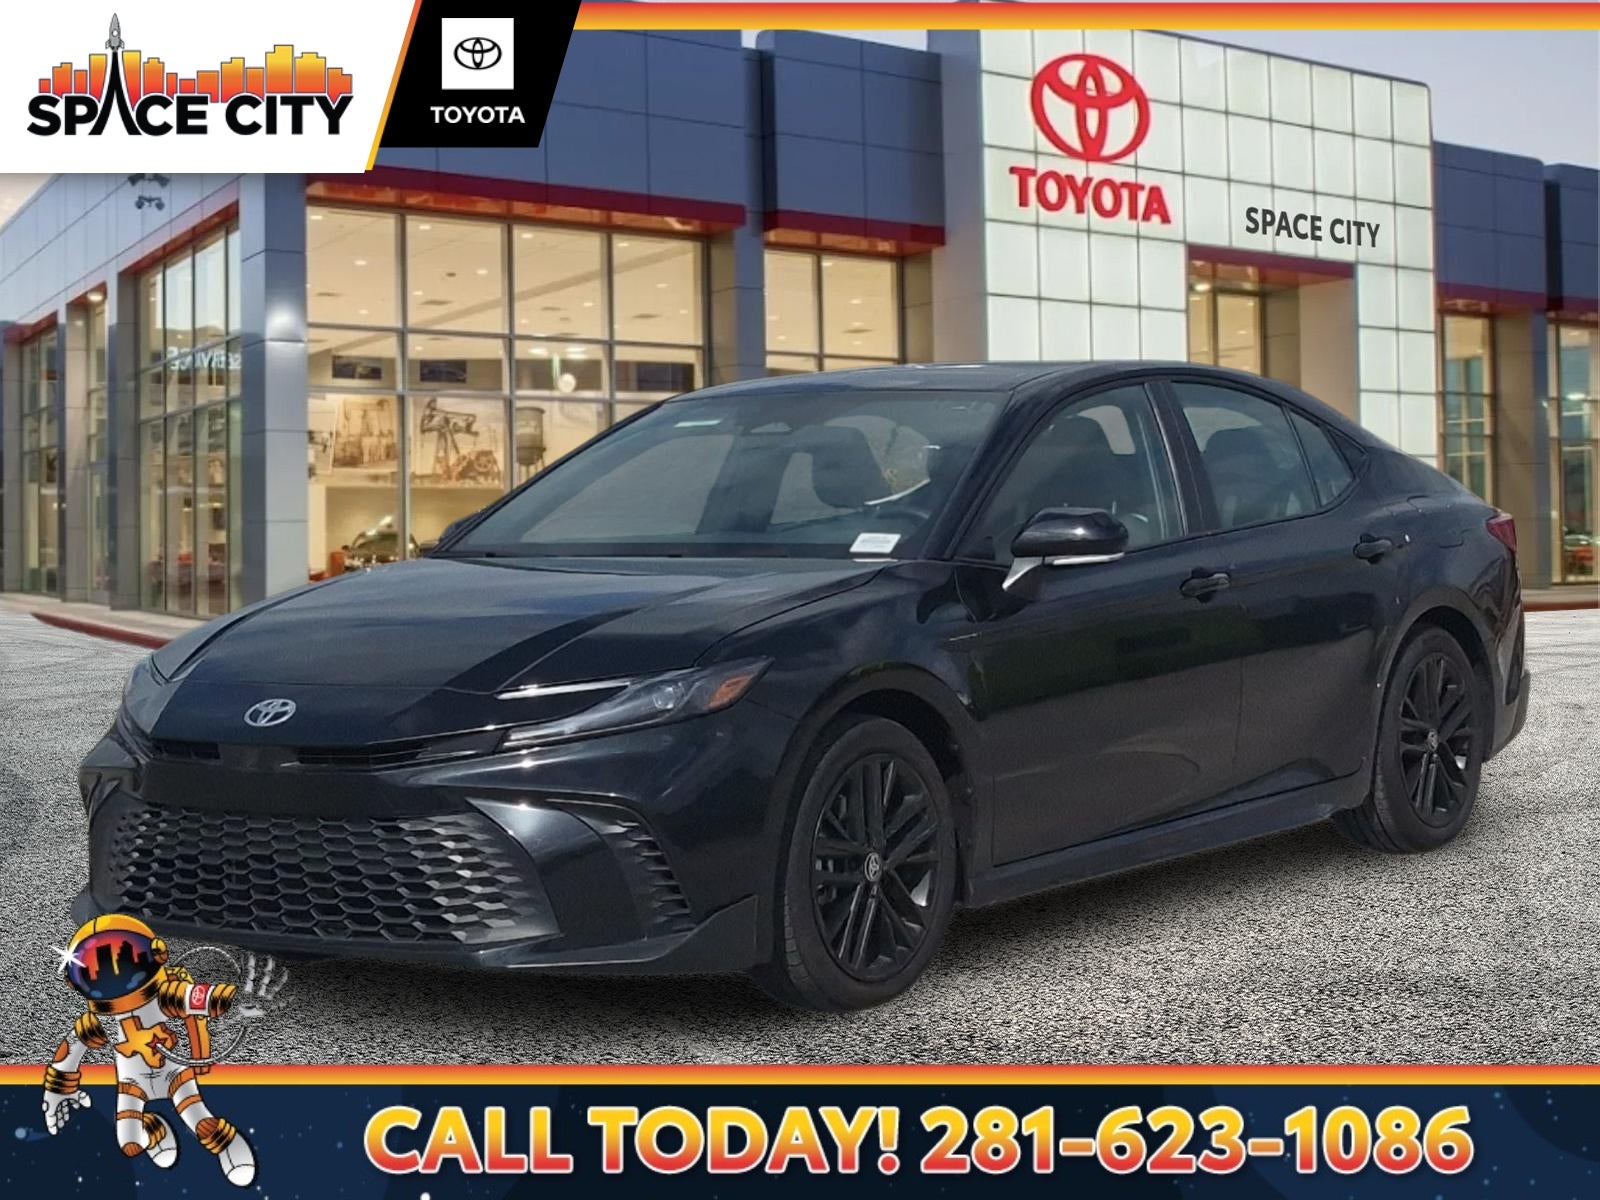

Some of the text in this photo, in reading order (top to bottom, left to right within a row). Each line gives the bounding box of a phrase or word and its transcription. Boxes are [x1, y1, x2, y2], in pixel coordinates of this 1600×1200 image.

[1009, 166, 1172, 225] TOYOTA
[1245, 206, 1381, 248] SPACE CITY
